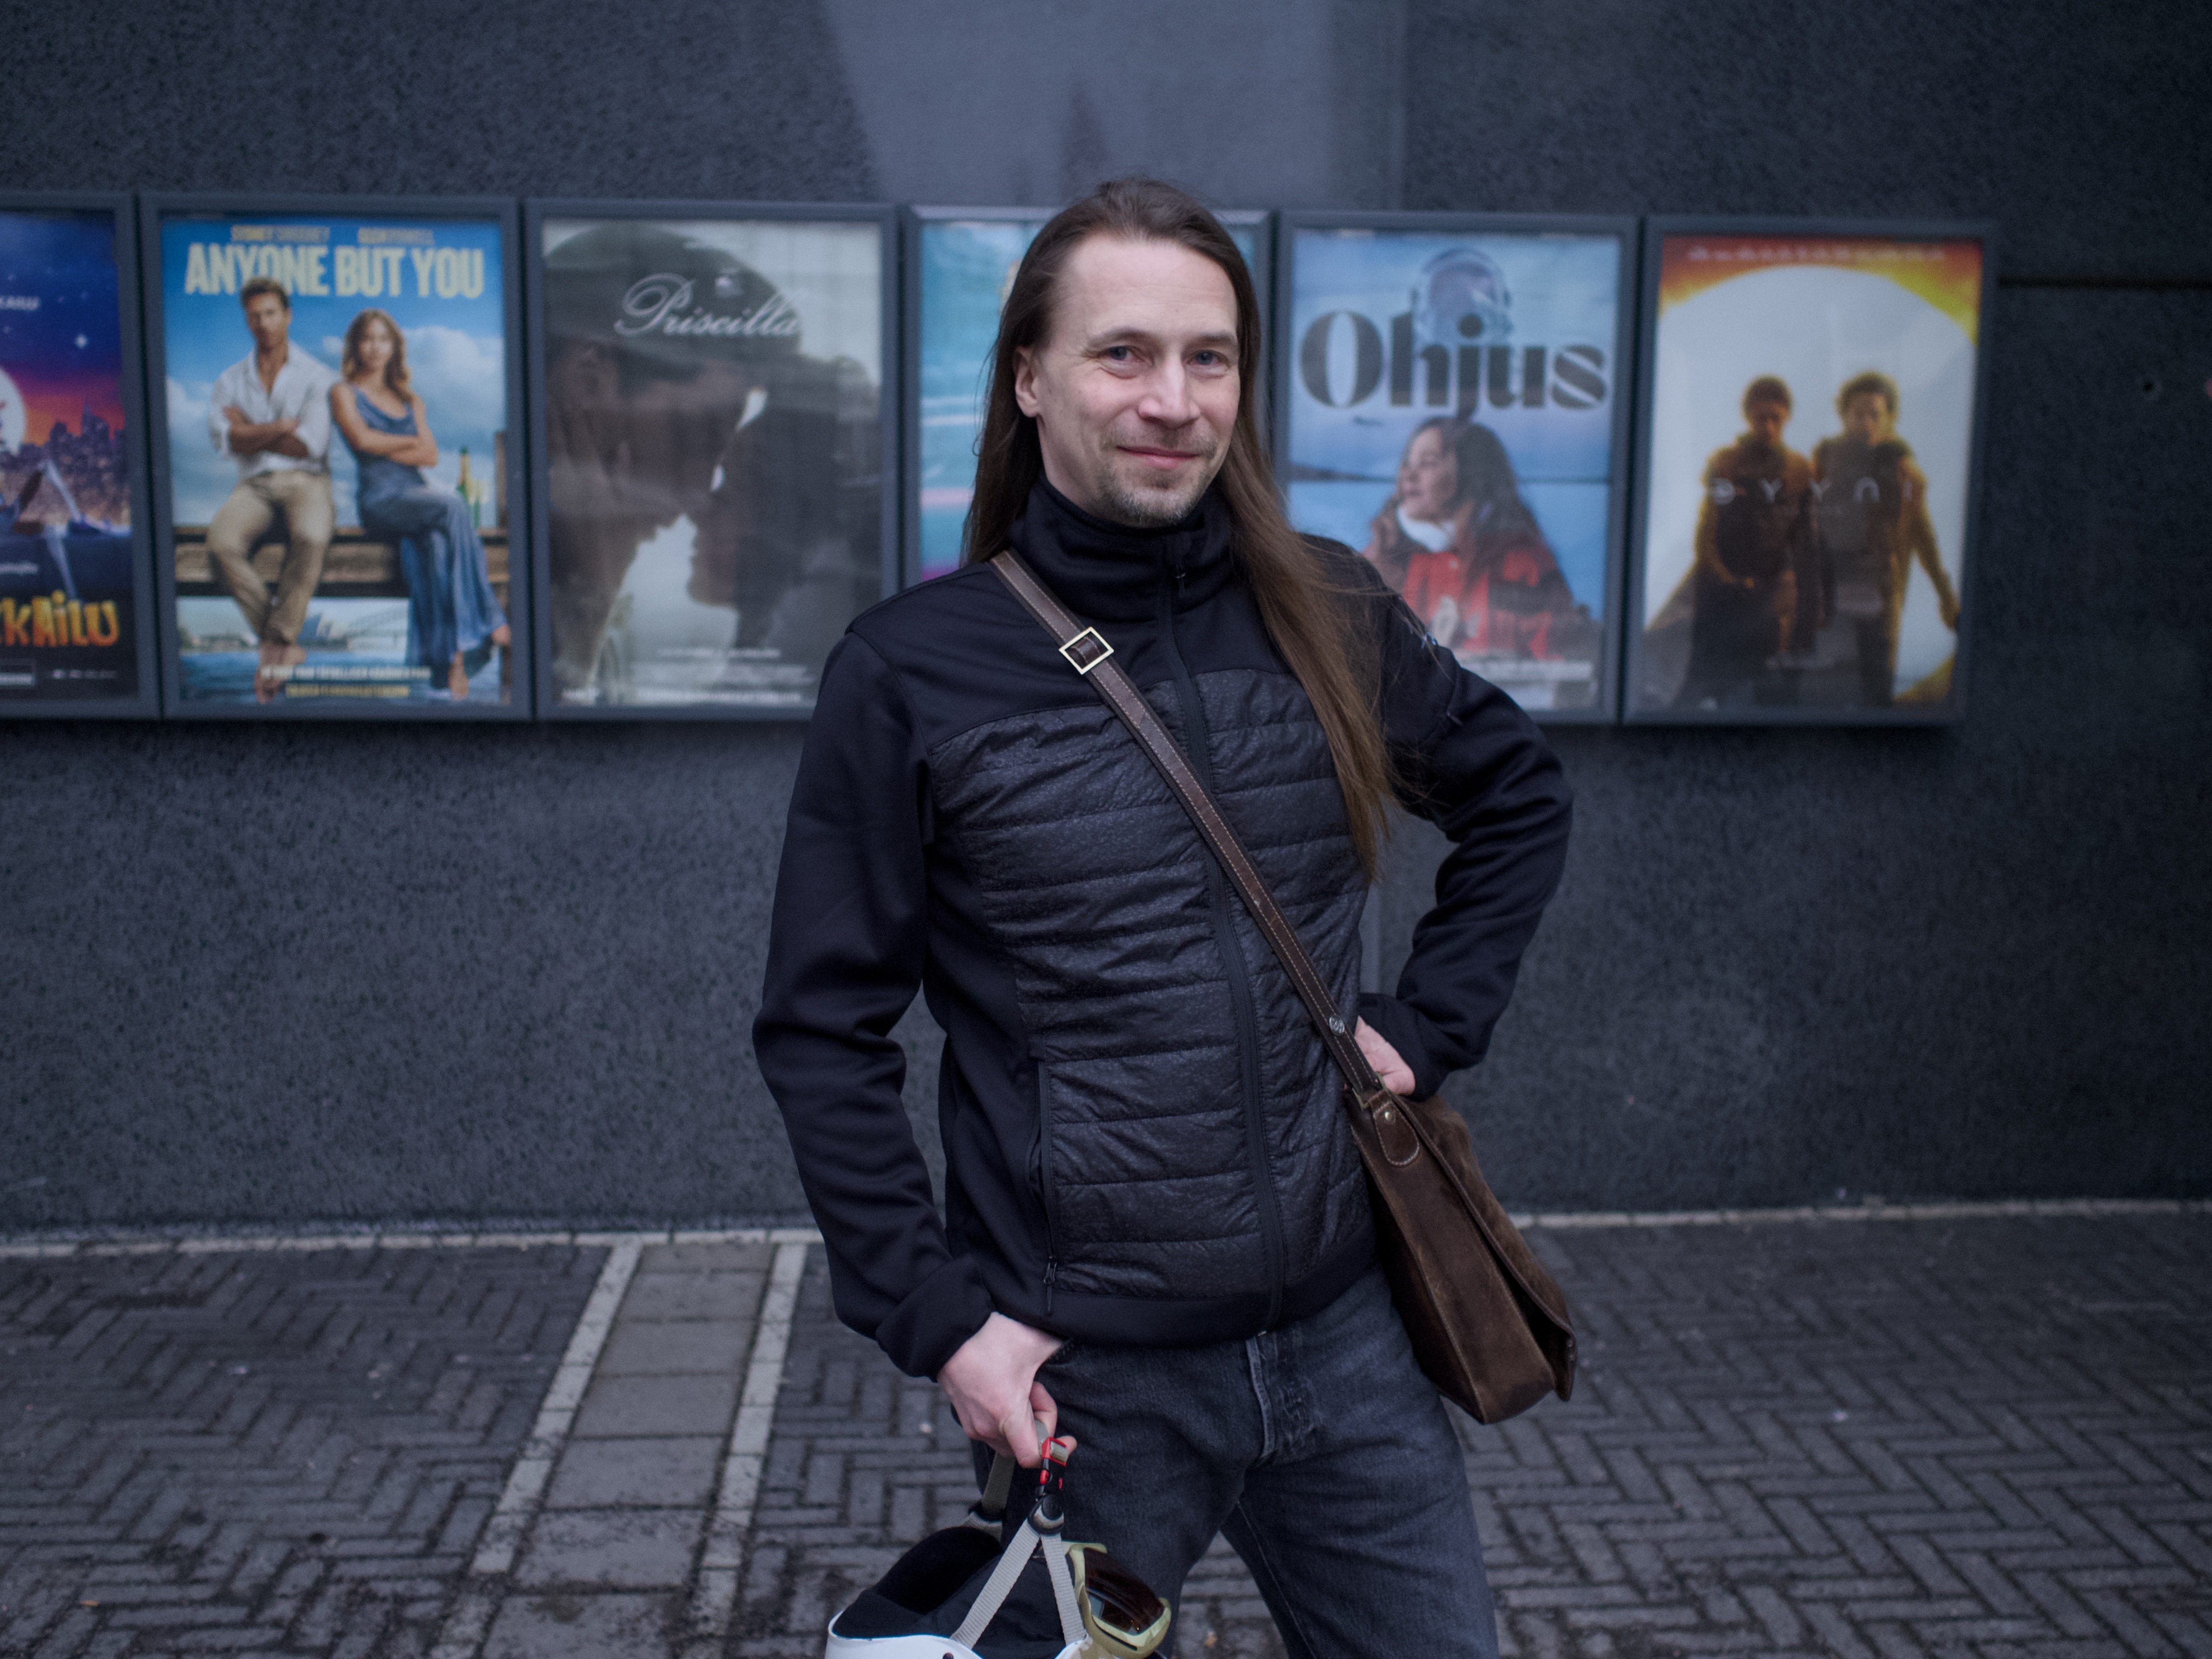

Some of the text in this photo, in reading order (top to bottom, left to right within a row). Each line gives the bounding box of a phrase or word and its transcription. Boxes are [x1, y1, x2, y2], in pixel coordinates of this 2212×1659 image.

[185, 242, 484, 298] ANYONE BUT YOU
[614, 272, 800, 337] Priscilla
[1300, 309, 1606, 419] Ohjus
